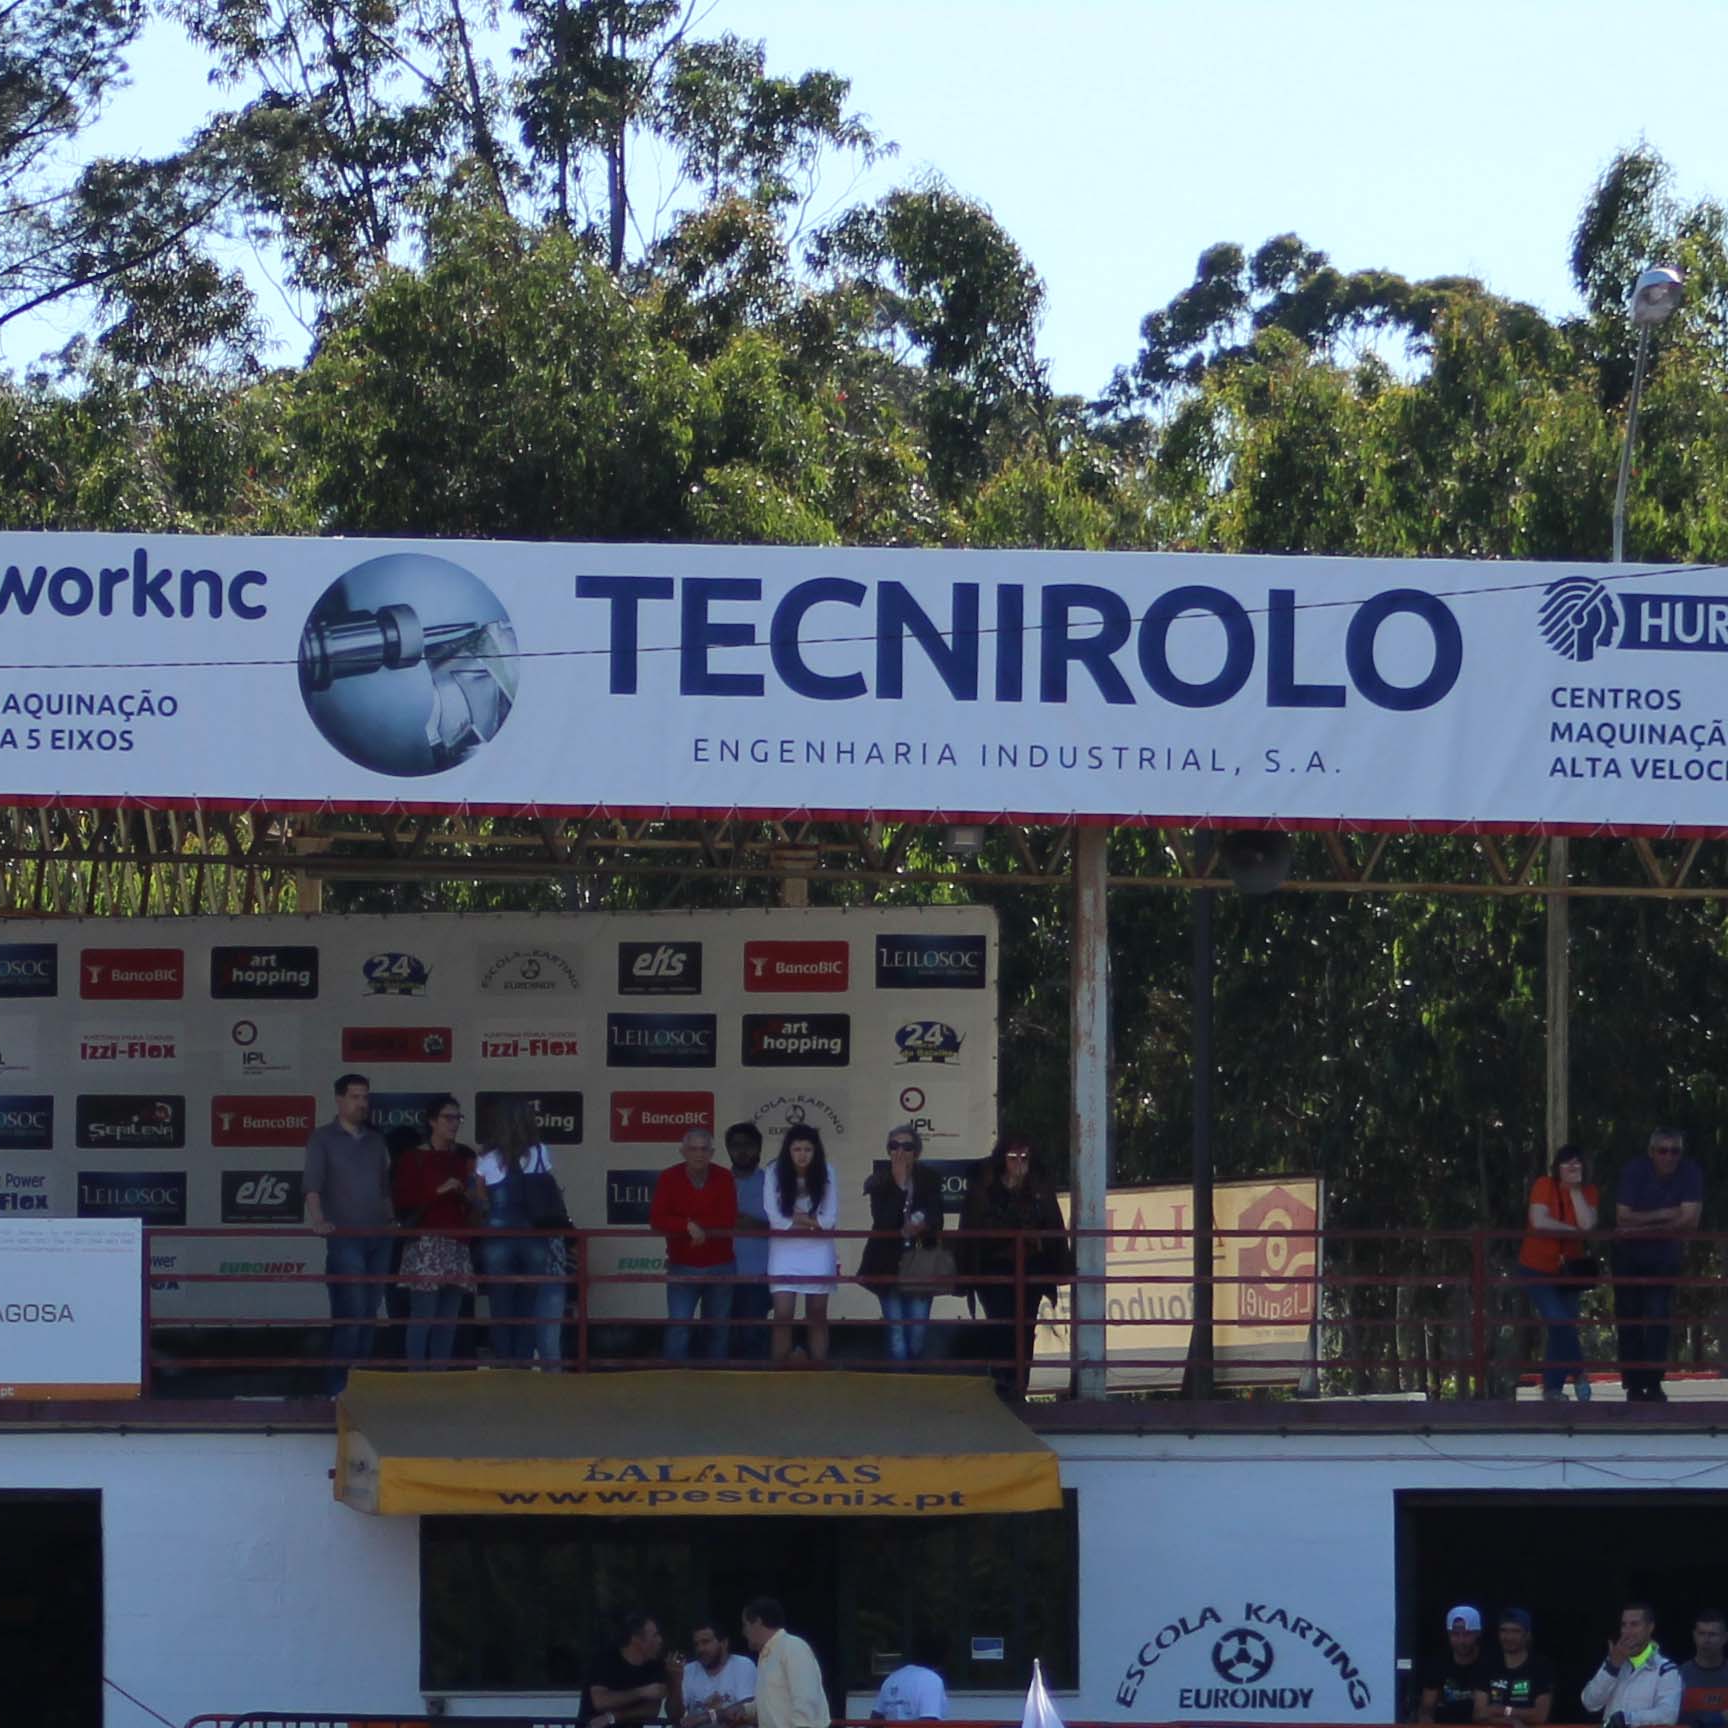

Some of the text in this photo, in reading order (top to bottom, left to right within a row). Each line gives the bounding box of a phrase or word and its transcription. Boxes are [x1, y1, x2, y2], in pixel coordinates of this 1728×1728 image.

[574, 575, 1463, 712] TECNIROLO
[1551, 686, 1682, 711] CENTROS
[26, 728, 41, 750] 5
[50, 729, 134, 751] EIXOS
[693, 738, 1342, 776] ENGENHARIA INDUSTRIAL, S.A.
[1549, 756, 1622, 779] ALTA
[249, 953, 278, 968] art
[371, 955, 411, 977] 24
[775, 961, 844, 975] BancoBIC
[879, 947, 979, 968] LEILOSOC
[111, 967, 177, 984] BancoBIC
[611, 1025, 709, 1047] LEILOSOC
[781, 1021, 808, 1034] art
[904, 1024, 944, 1046] 24
[242, 1051, 266, 1065] IPL
[480, 1039, 578, 1058] Izzi-Flex
[243, 1115, 309, 1129] BancoBIC
[641, 1111, 709, 1125] BancoBIC
[5, 1172, 46, 1188] Power
[81, 1184, 180, 1206] LEILOSOC
[218, 1261, 307, 1274] EUROINDY
[493, 1486, 968, 1512] www.pestronix.pt
[1115, 1602, 1372, 1711] ESCOLA KARTING
[1178, 1687, 1315, 1710] EUROINDY
